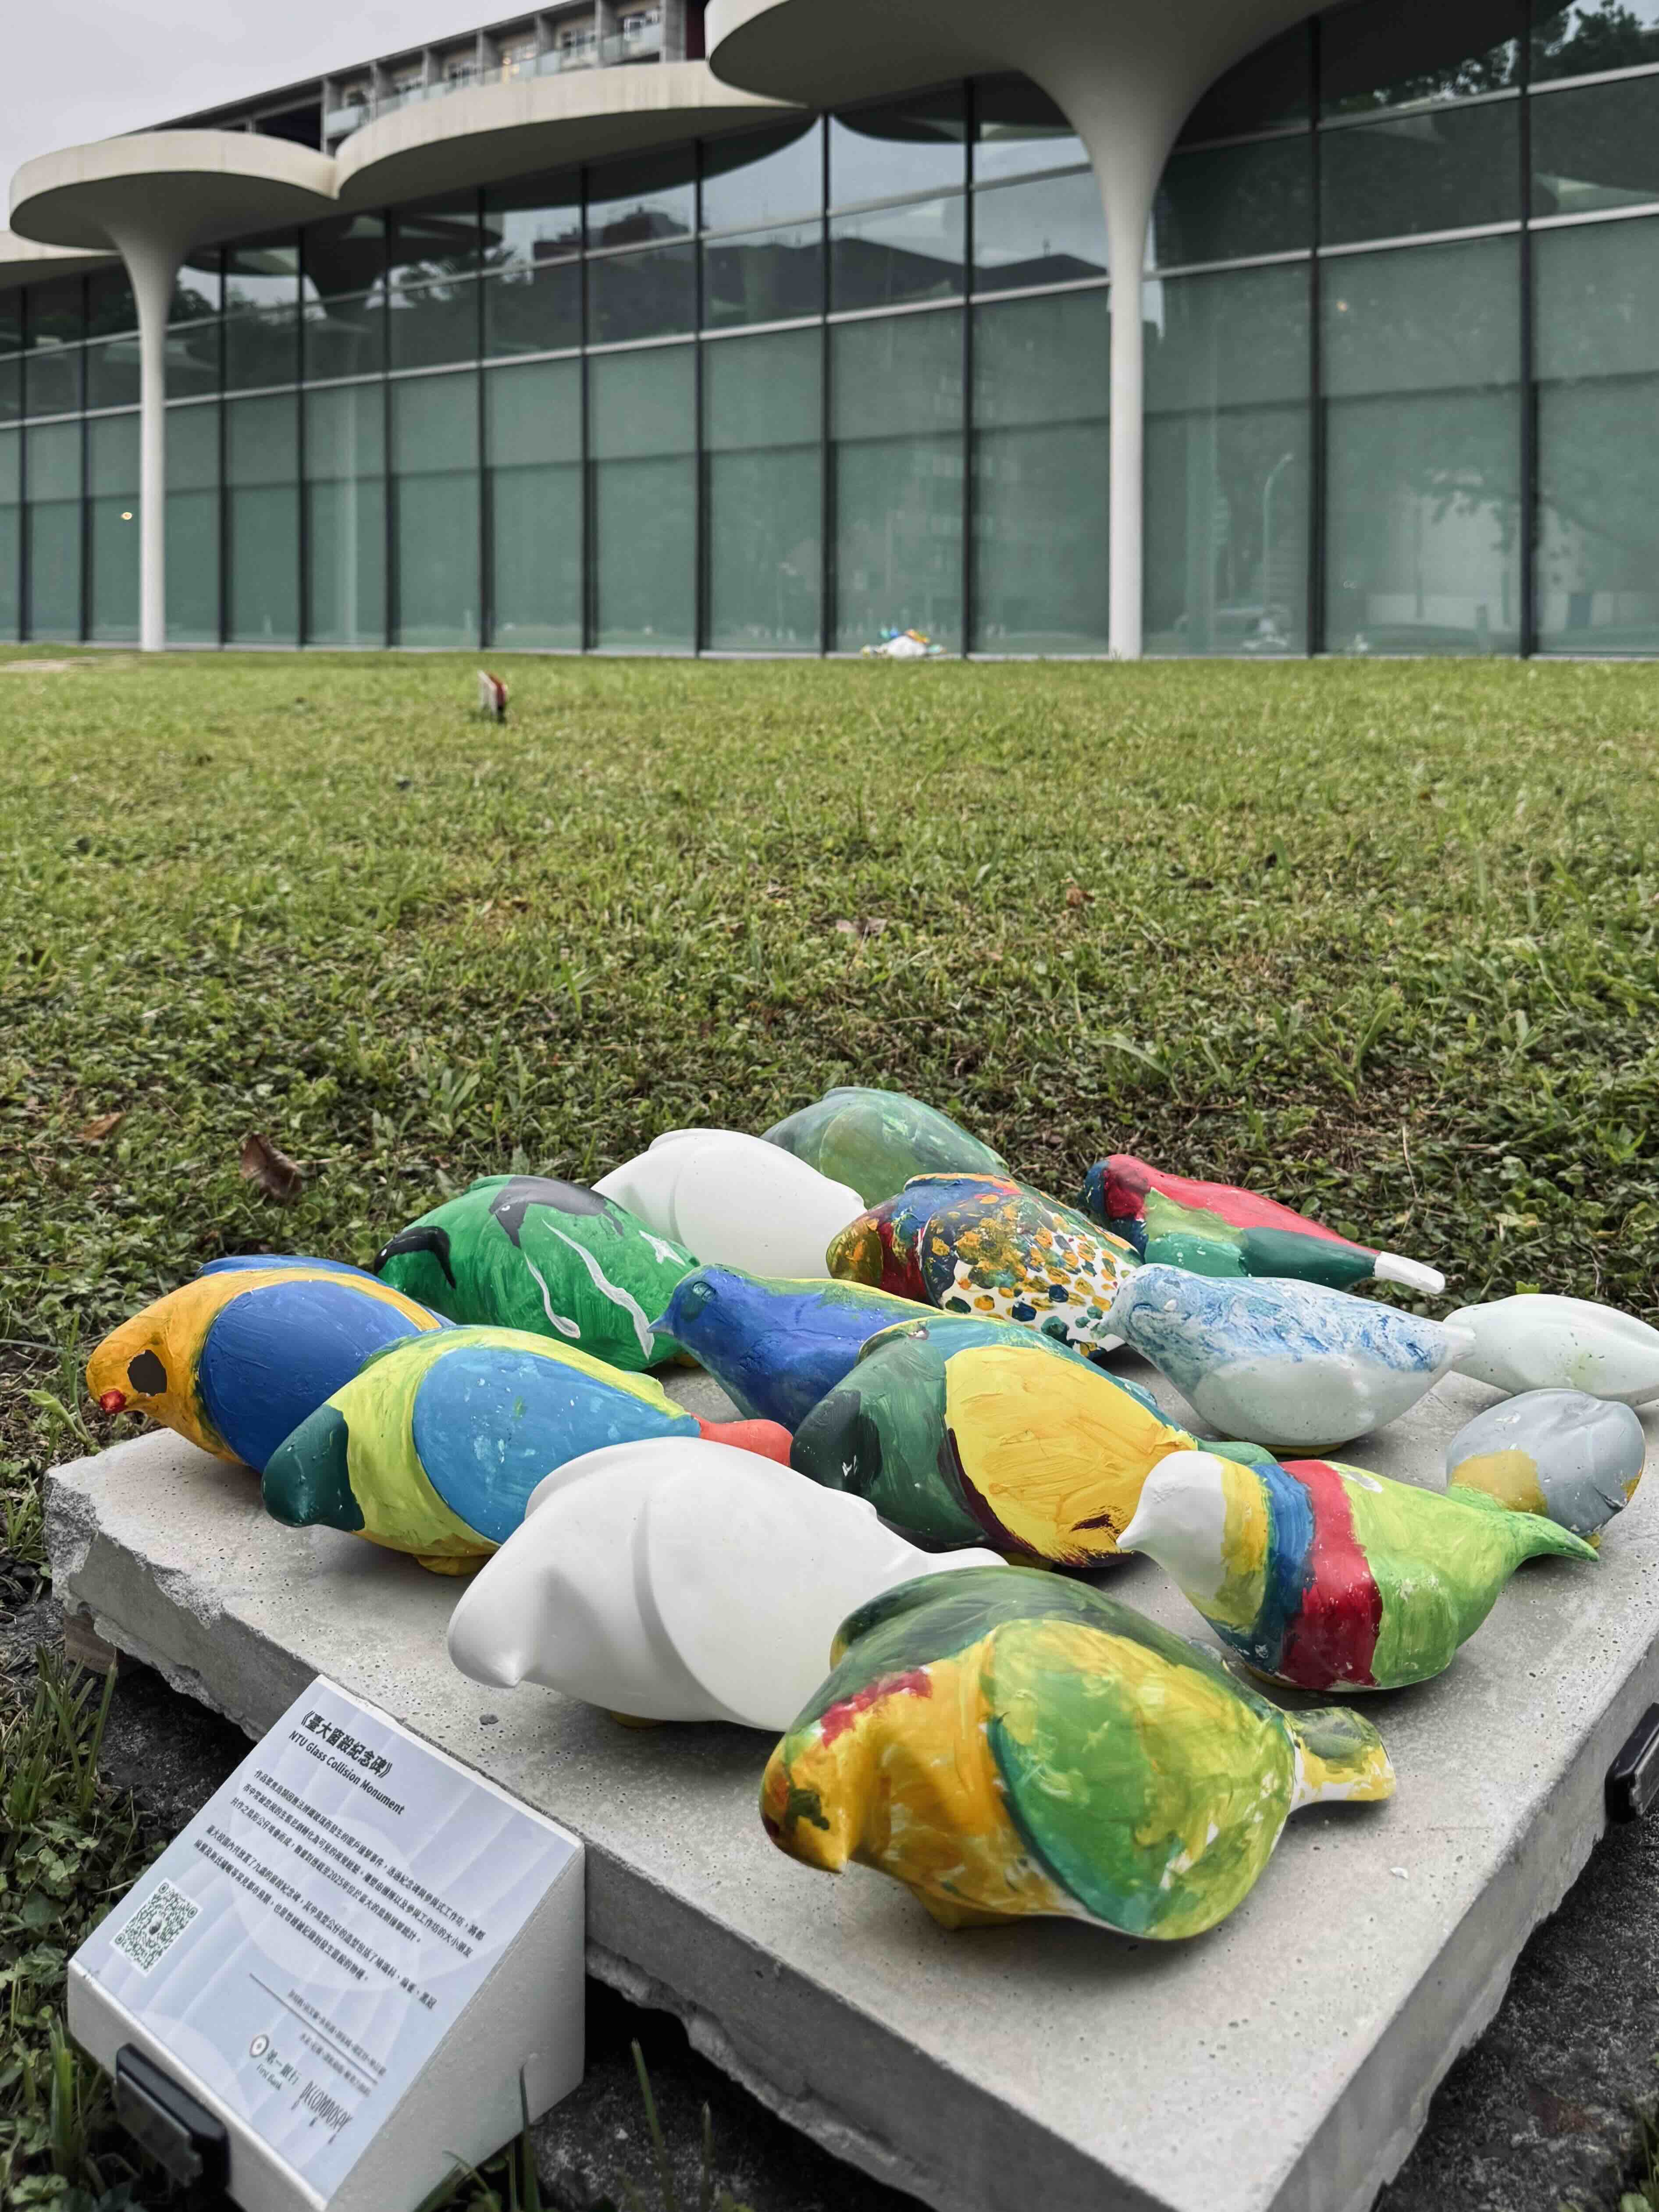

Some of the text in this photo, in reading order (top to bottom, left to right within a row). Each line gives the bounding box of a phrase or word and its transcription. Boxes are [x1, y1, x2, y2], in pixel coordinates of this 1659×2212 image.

[299, 1709, 395, 1780] 《臺大窗殺紀念碑》
[288, 1730, 406, 1815] NTU Glass Collision Monument
[256, 2062, 282, 2091] First Bank
[264, 2048, 302, 2085] 第一銀行
